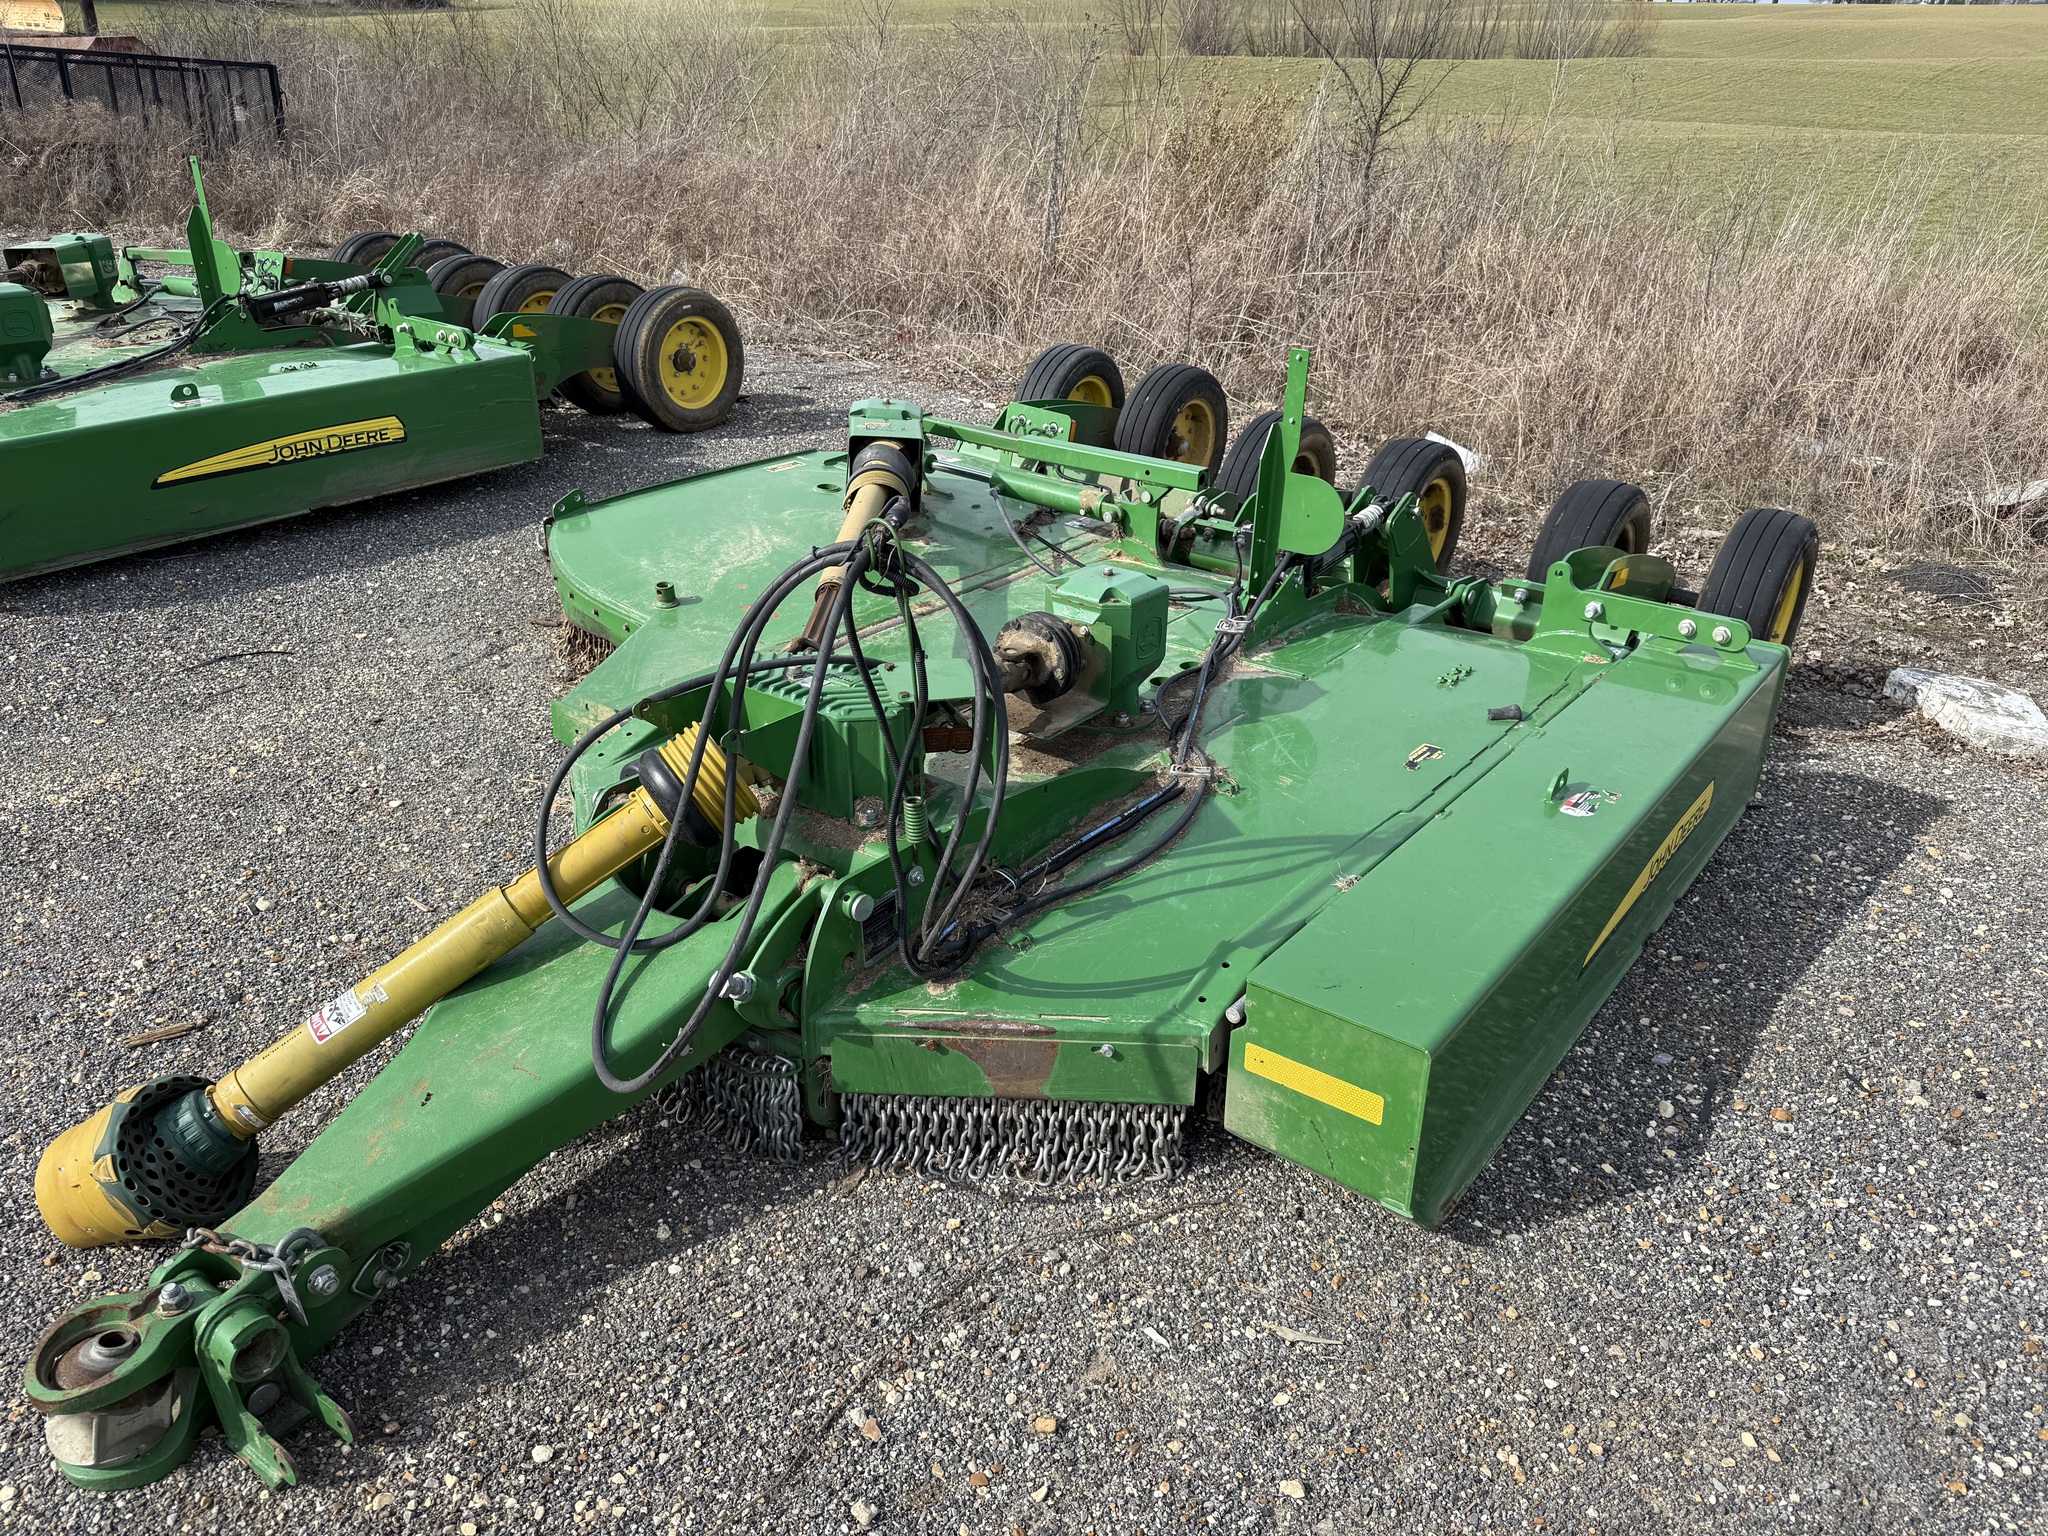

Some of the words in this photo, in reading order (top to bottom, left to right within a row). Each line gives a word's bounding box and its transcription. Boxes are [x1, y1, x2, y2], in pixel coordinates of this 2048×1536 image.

[267, 440, 323, 462] JOHN
[327, 429, 391, 450] DEERE
[1641, 838, 1676, 893] JOHN
[1673, 799, 1707, 853] DEERE
